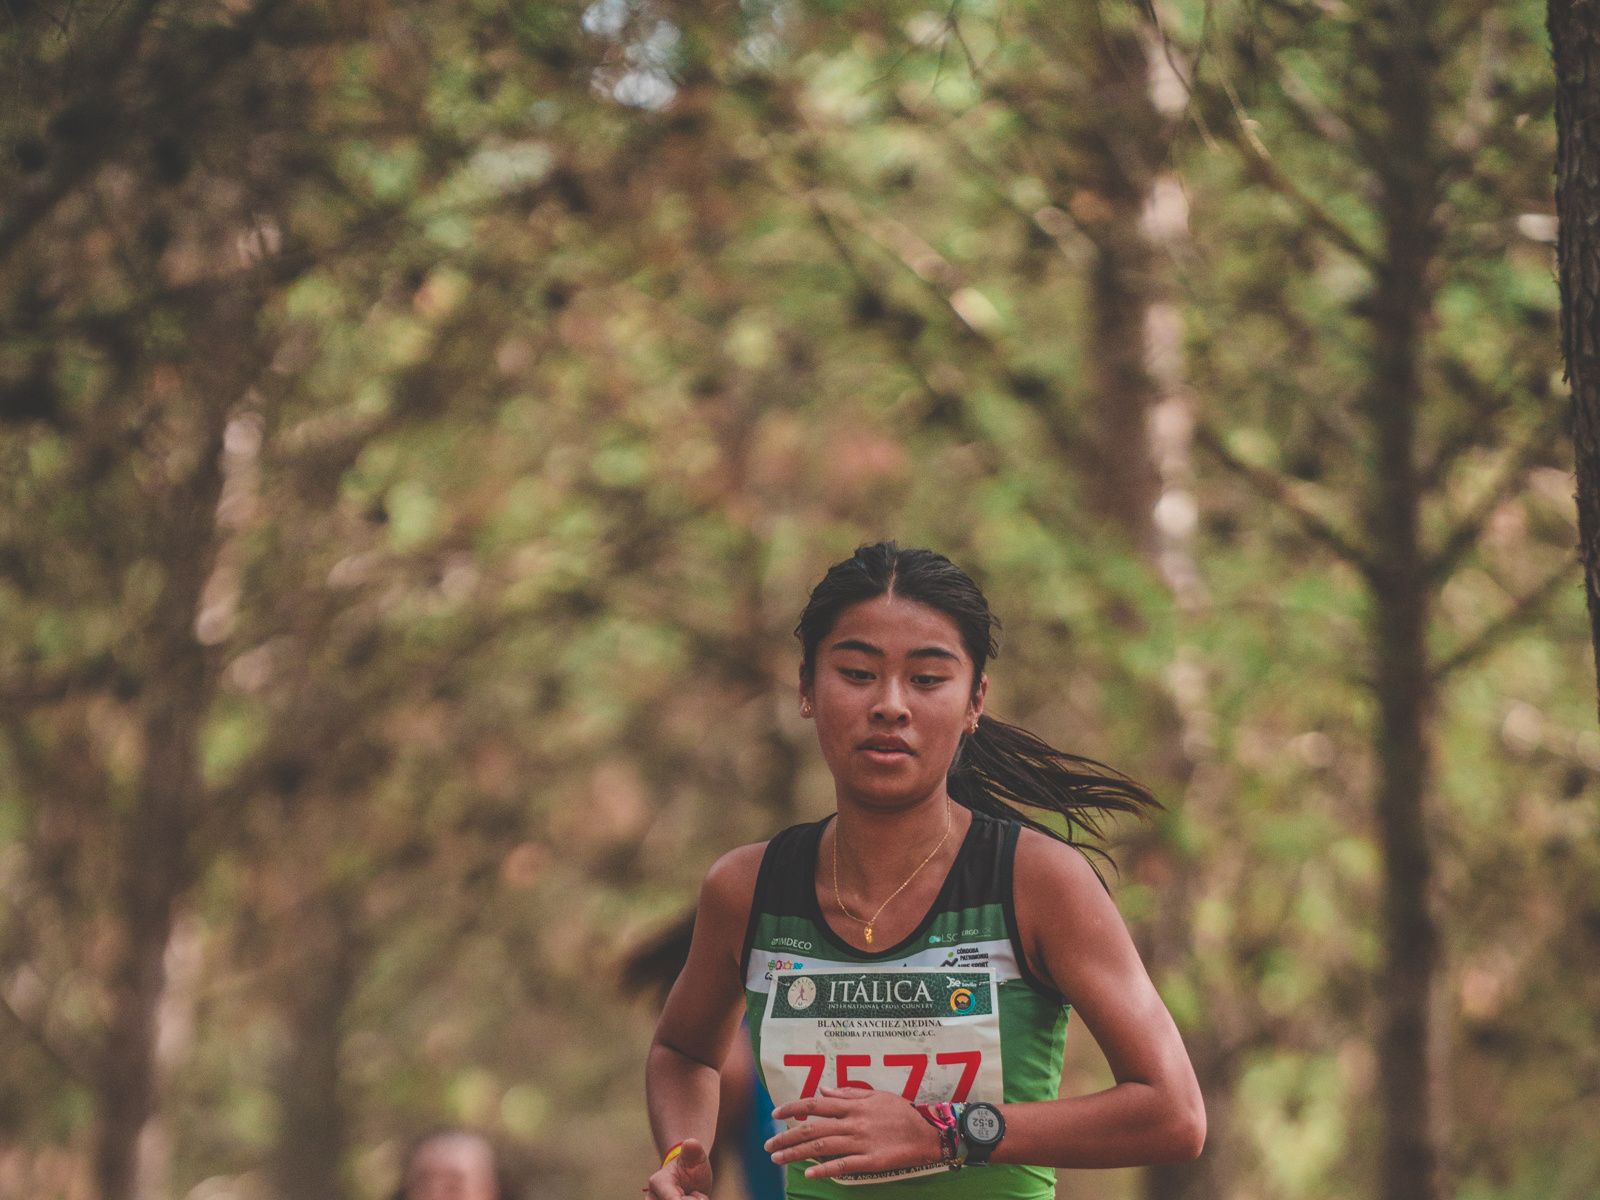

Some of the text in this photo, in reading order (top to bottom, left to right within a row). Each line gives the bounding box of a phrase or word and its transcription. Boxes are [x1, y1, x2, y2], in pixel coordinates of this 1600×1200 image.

[829, 974, 934, 1003] ITÁLICA
[828, 1002, 879, 1010] INTERNATIONAL
[817, 1018, 942, 1028] BLANCA SANCHEZ MEDINA
[862, 1030, 911, 1038] PATRIMONIO
[913, 1030, 936, 1038] C.A.C.
